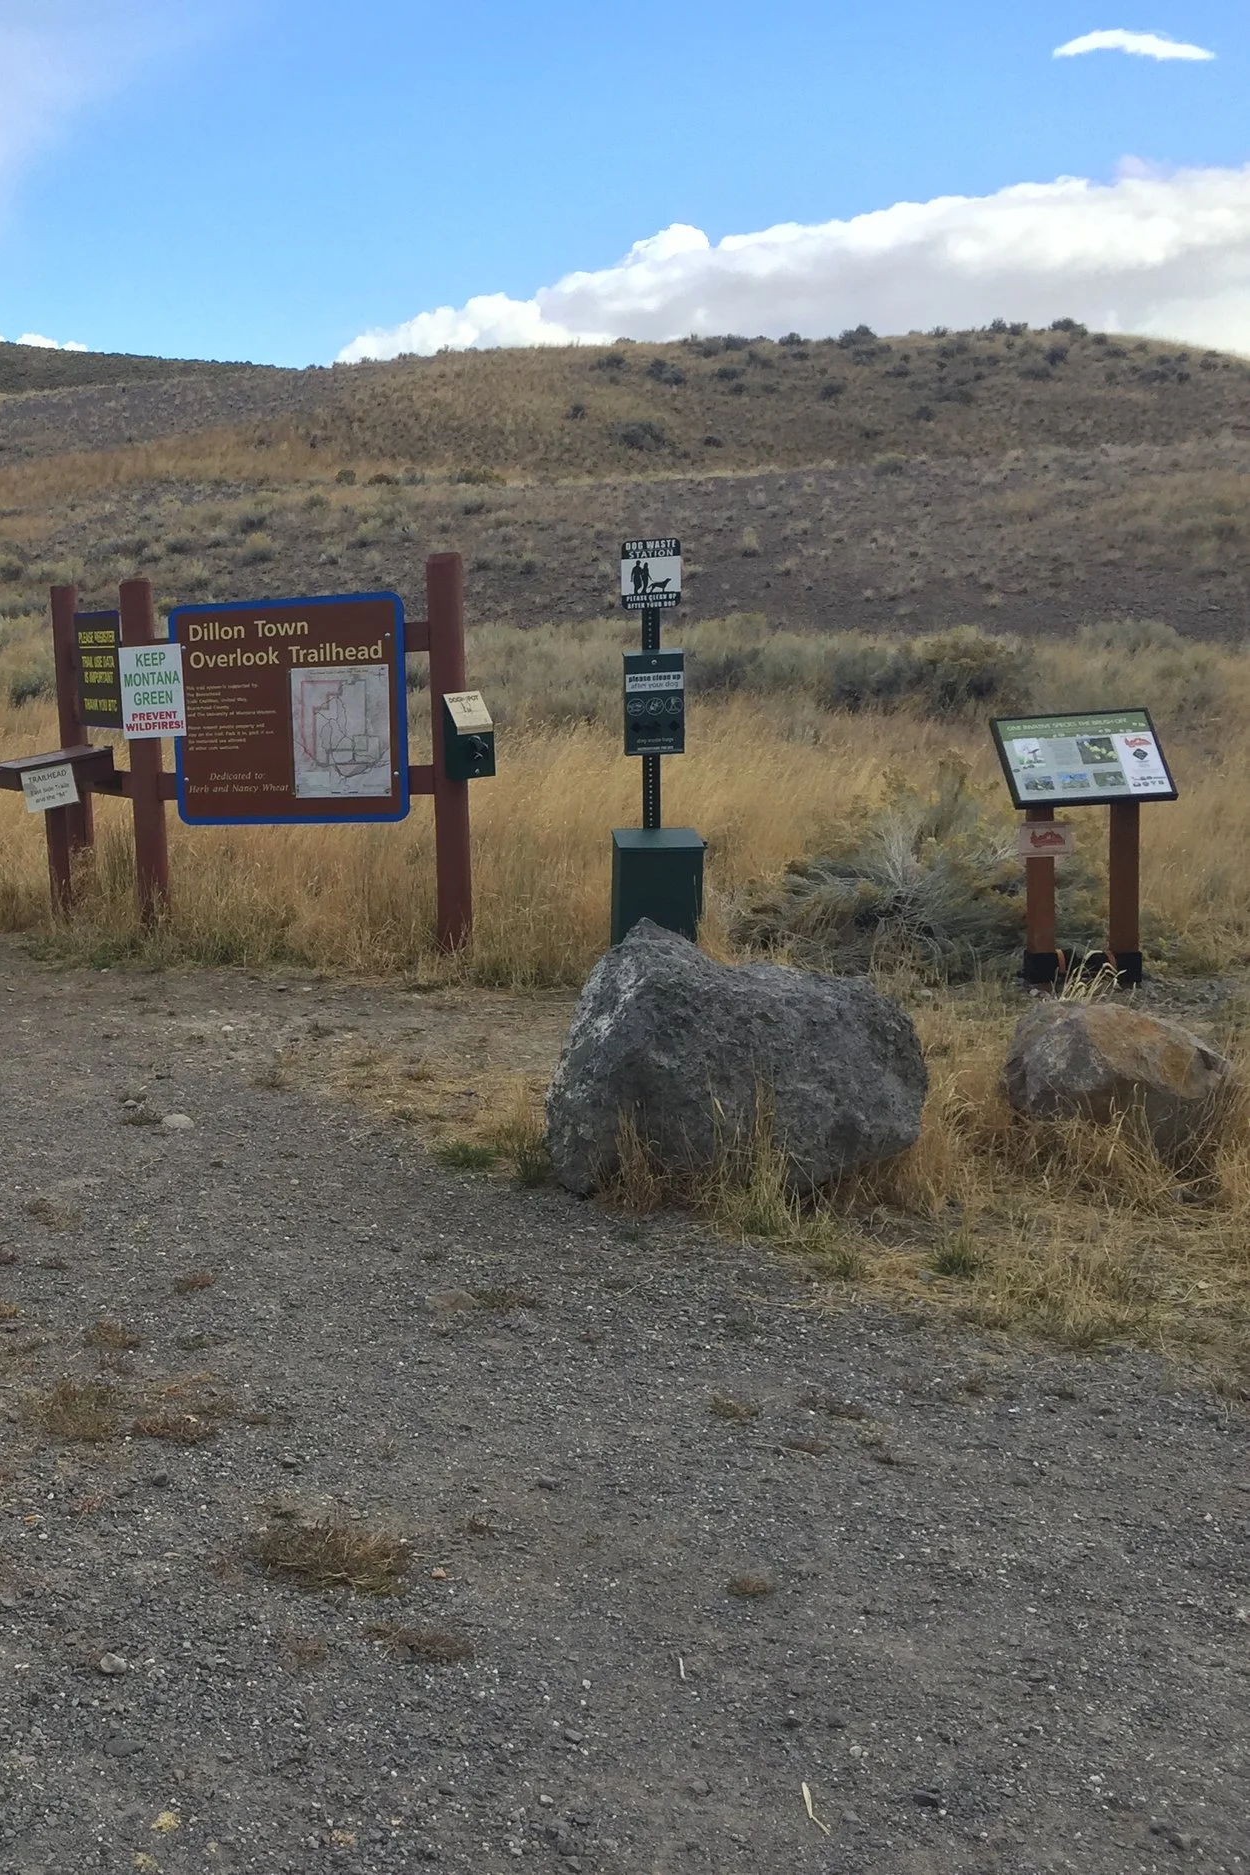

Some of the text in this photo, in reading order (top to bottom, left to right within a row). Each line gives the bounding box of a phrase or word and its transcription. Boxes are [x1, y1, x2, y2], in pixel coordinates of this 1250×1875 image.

[625, 539, 676, 550] DOG WASTE
[629, 549, 673, 559] STATION
[188, 620, 309, 642] Dillon Town
[78, 632, 94, 643] PLEASE
[135, 652, 166, 667] KEEP
[189, 640, 383, 669] Overlook Trailhead
[81, 655, 115, 668] TRAIL USE DATA
[84, 671, 114, 684] IS IMPORTANT
[124, 670, 180, 687] MONTANA
[665, 680, 679, 688] dog
[84, 697, 98, 711] THANK
[98, 698, 108, 711] YOU
[133, 690, 173, 706] GREEN
[131, 710, 178, 721] PREVENT
[125, 720, 184, 732] WILDFIRES!
[1052, 721, 1077, 729] SPECIES
[28, 768, 67, 783] TRAILHEAD
[210, 772, 252, 781] Dedicated
[189, 783, 289, 794] Herb and Nancy Wheat
